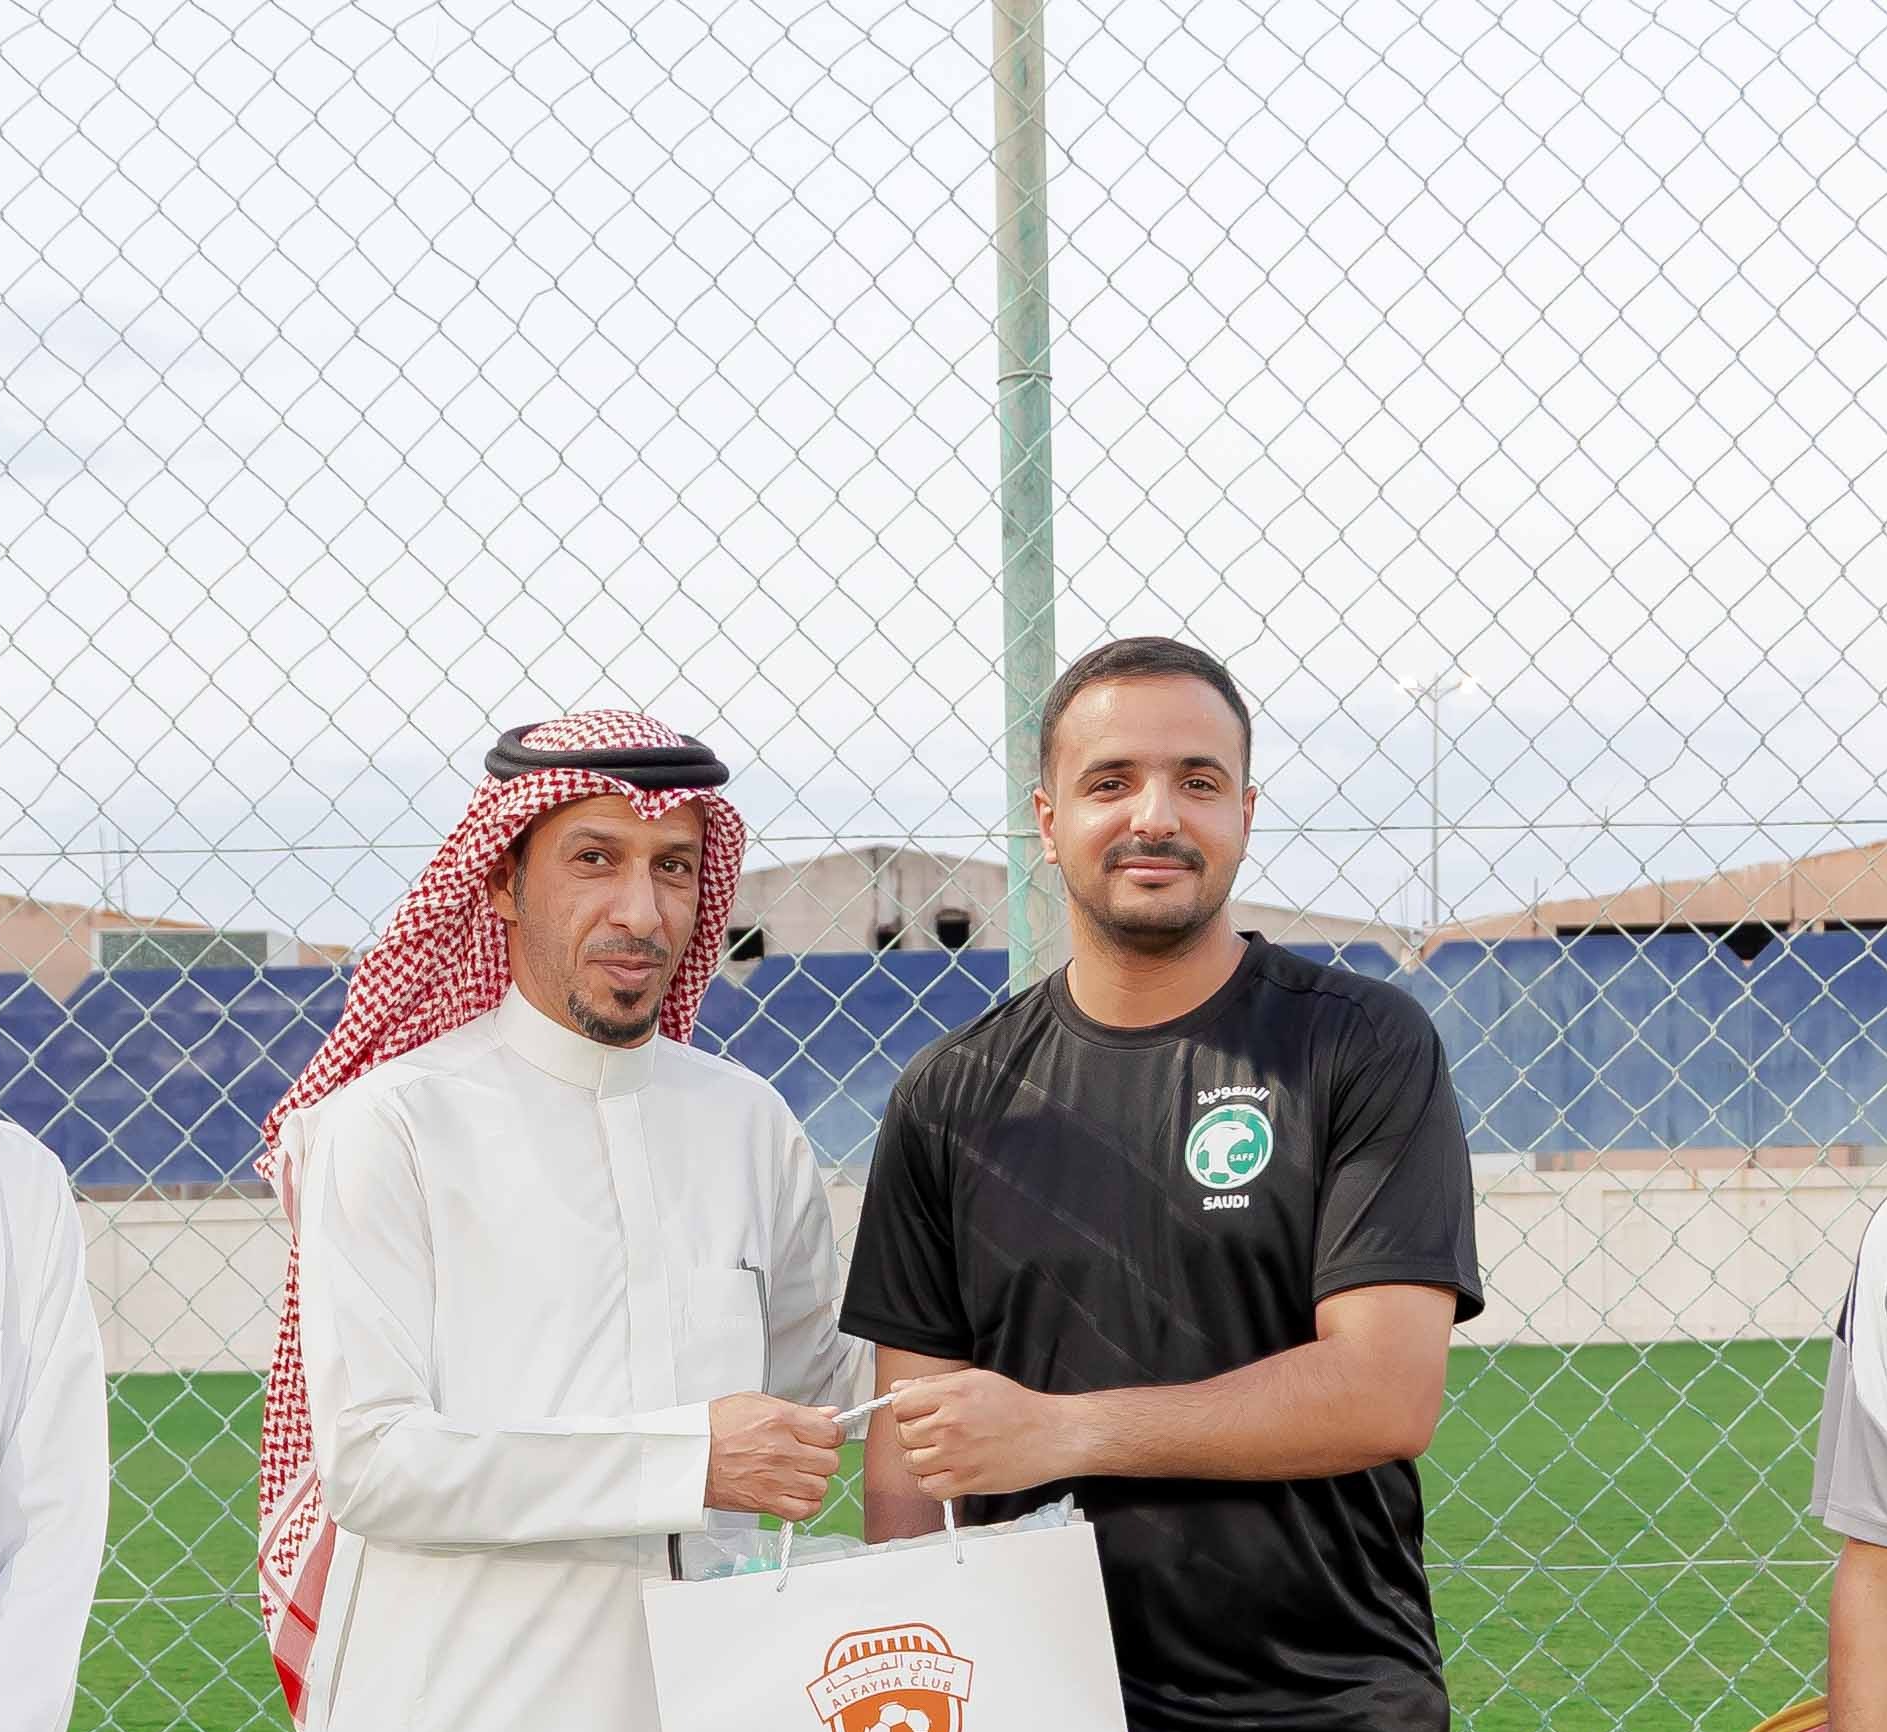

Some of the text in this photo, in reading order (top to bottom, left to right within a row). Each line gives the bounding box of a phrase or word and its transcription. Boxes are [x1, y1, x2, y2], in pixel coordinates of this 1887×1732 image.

[1197, 1085, 1271, 1105] السعودية
[1229, 1152, 1254, 1162] SAFF
[1202, 1194, 1250, 1211] SAUDI
[825, 1654, 956, 1694] نادي الفيحاء
[831, 1675, 952, 1709] ALFAYHA CLUB
